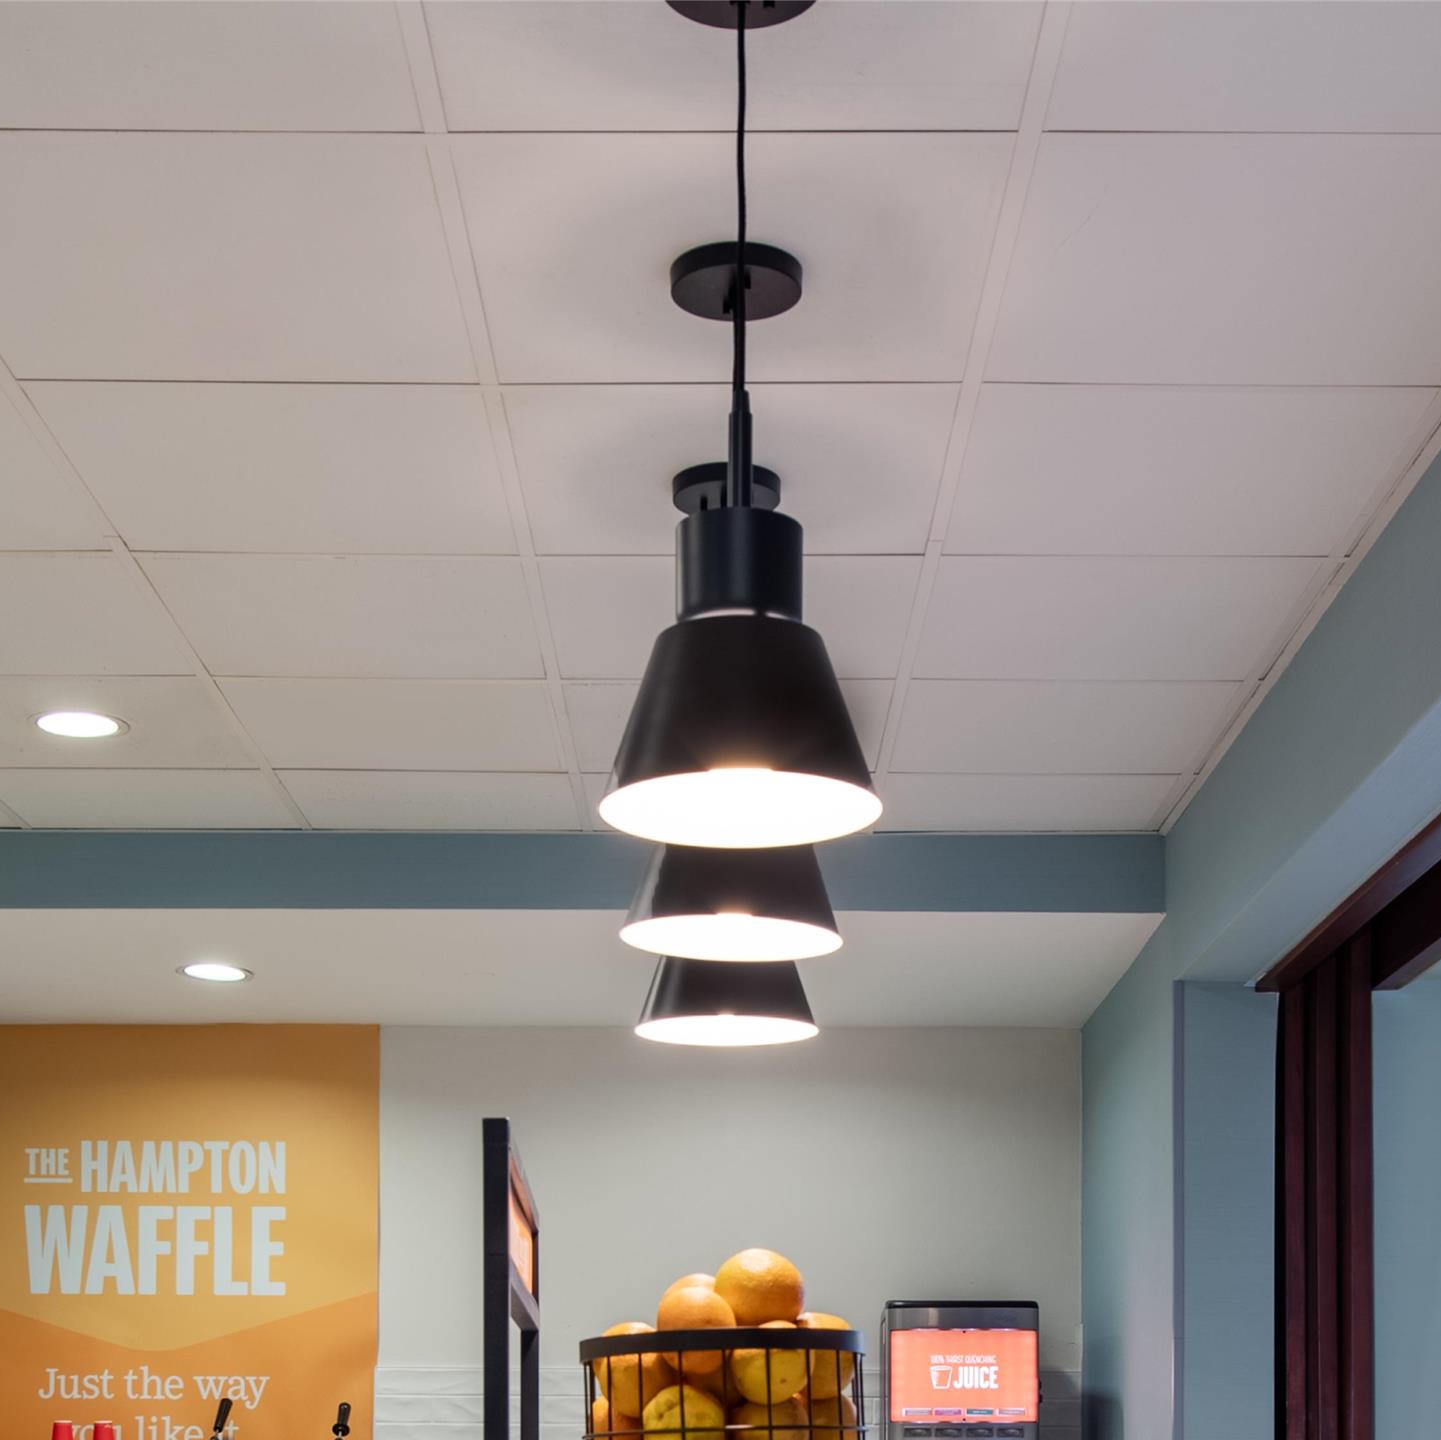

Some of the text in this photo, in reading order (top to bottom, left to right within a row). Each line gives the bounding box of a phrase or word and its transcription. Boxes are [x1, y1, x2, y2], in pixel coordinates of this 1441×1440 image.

[24, 1140, 287, 1195] THE HAMPTON
[24, 1204, 287, 1296] WAFFLE
[38, 1365, 271, 1410] Just the way
[953, 1365, 999, 1389] JUICE
